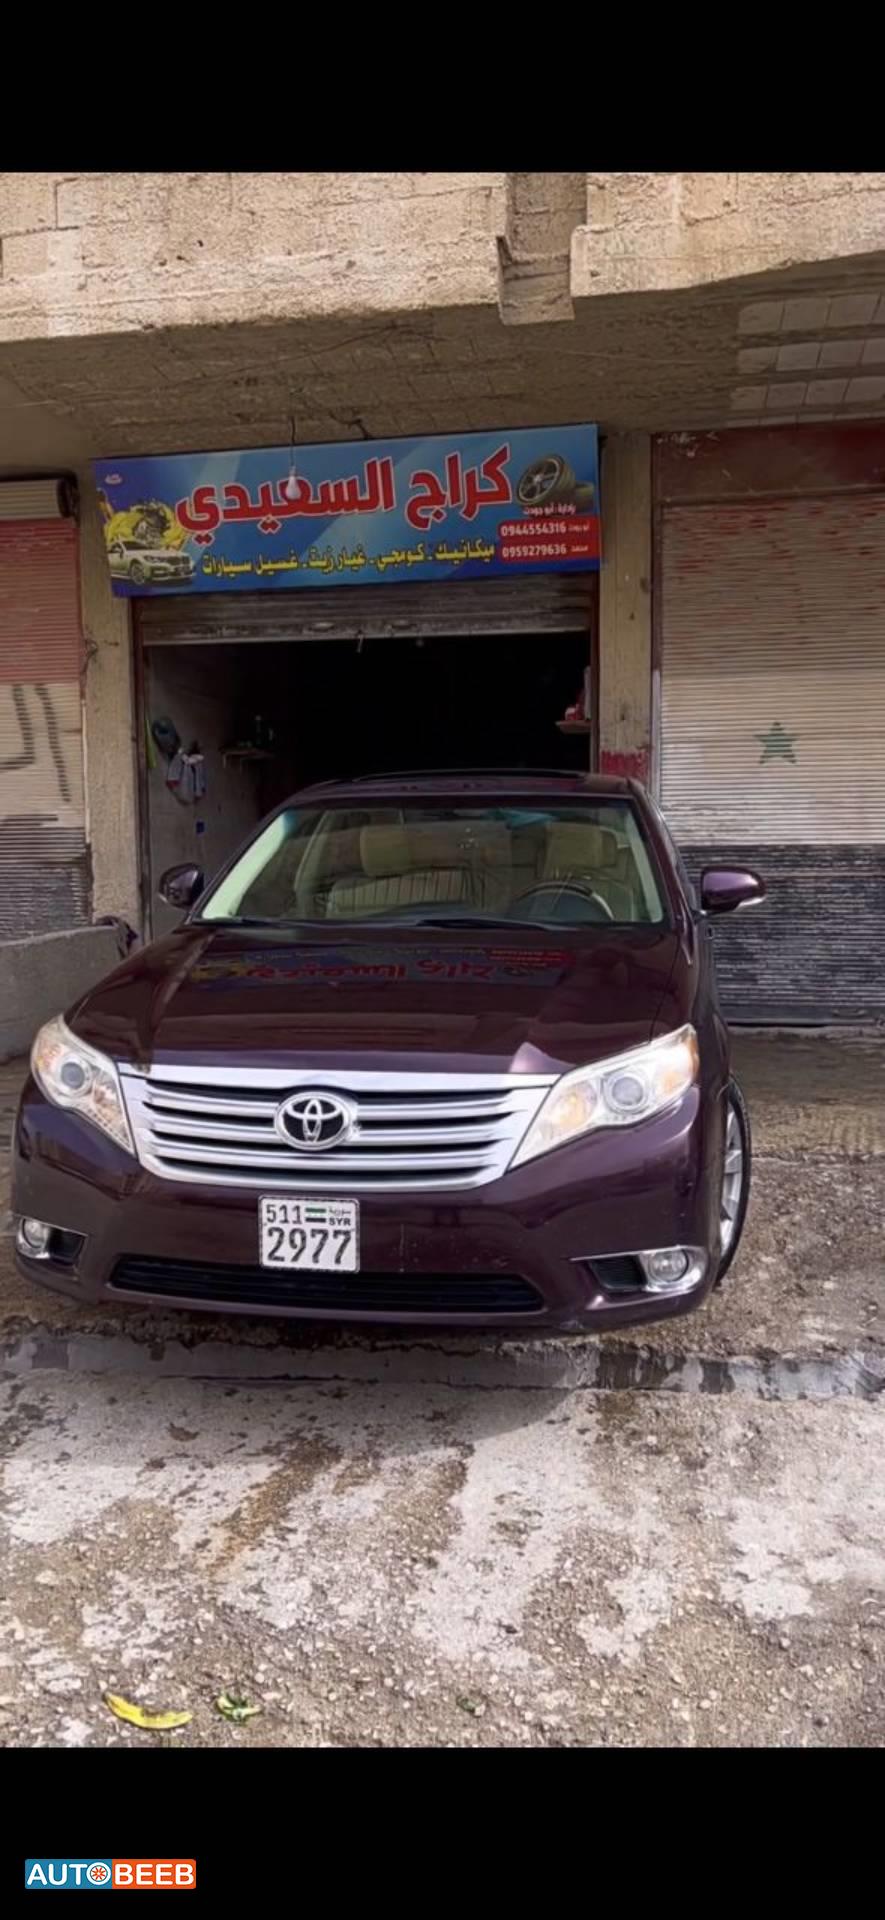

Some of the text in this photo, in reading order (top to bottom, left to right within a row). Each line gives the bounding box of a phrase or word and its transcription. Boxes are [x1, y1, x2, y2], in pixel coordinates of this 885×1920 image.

[176, 443, 511, 547] كراج السعيدي
[500, 521, 567, 537] 0944554316
[255, 548, 299, 576] غسيل
[308, 545, 335, 575] زيت
[377, 542, 425, 572] كومجي
[435, 538, 496, 565] ميكانيك
[502, 544, 568, 558] 0959279636
[202, 553, 252, 579] سيارات
[266, 1204, 303, 1224] 511
[329, 1217, 351, 1226] SYR
[267, 1227, 352, 1265] 2977
